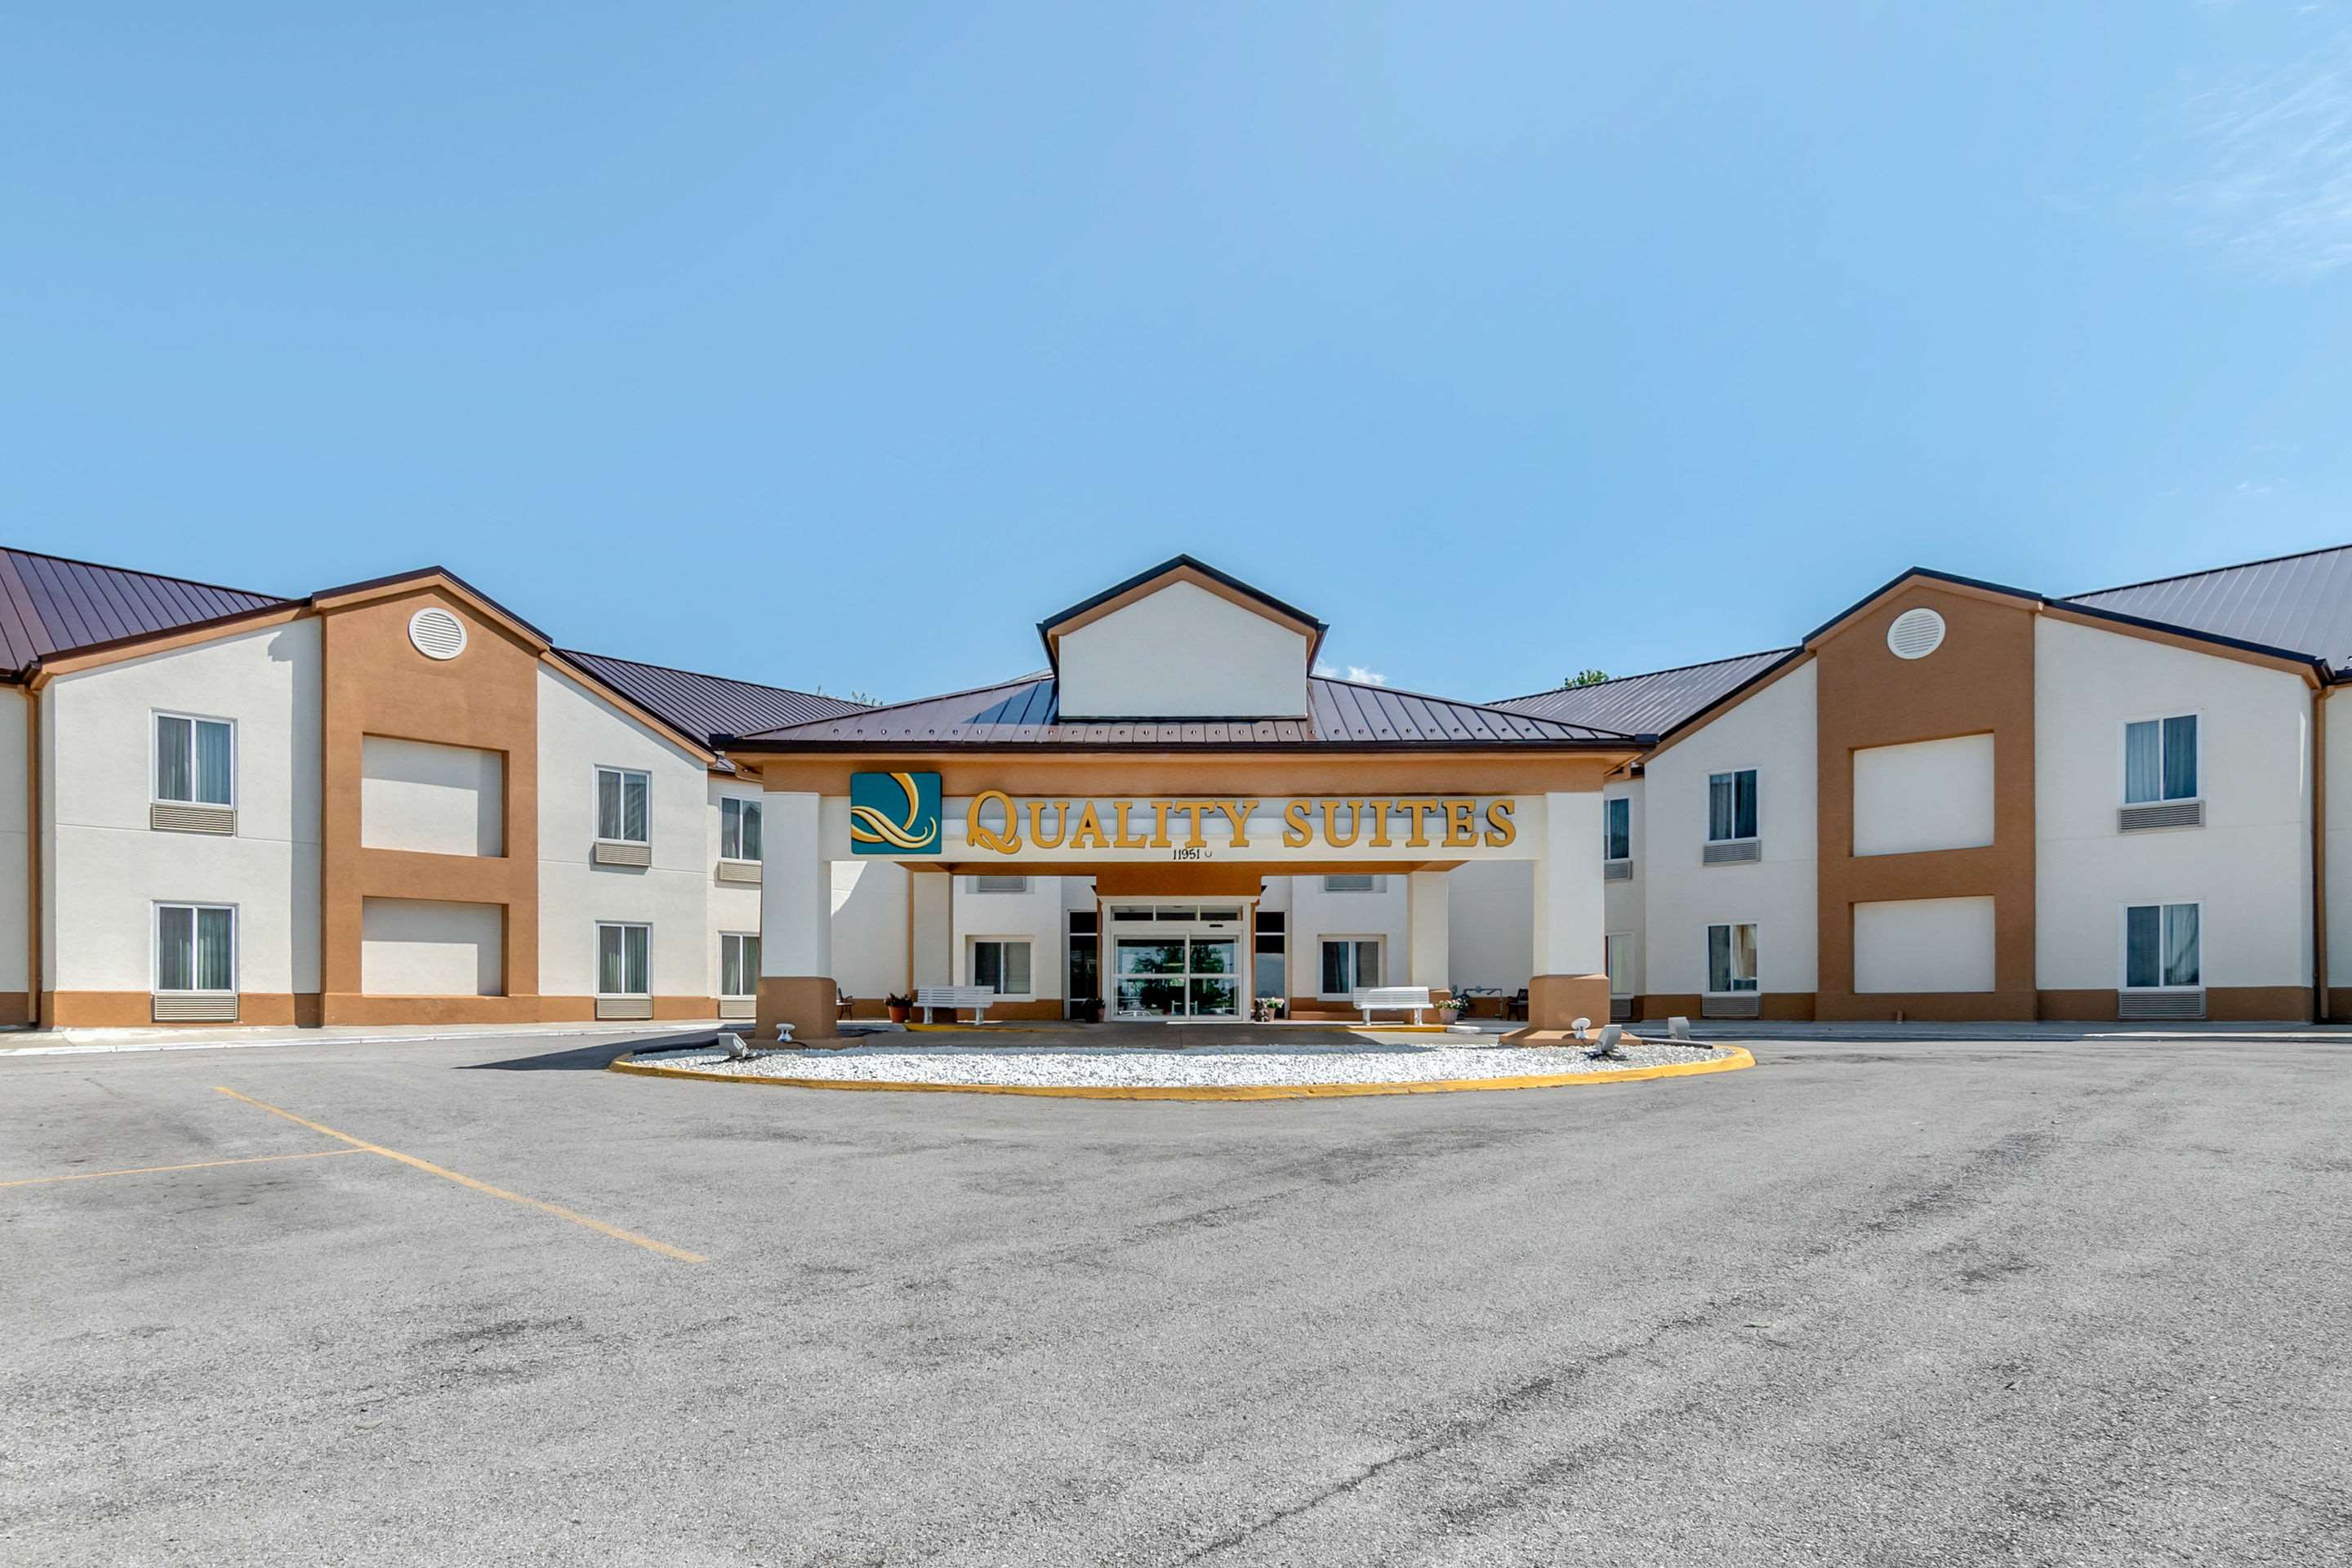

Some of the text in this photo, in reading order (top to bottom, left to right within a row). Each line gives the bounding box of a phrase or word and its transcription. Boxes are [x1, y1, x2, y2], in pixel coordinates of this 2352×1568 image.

[967, 790, 1517, 854] QUALITY SUITES
[1173, 849, 1200, 860] 11951
